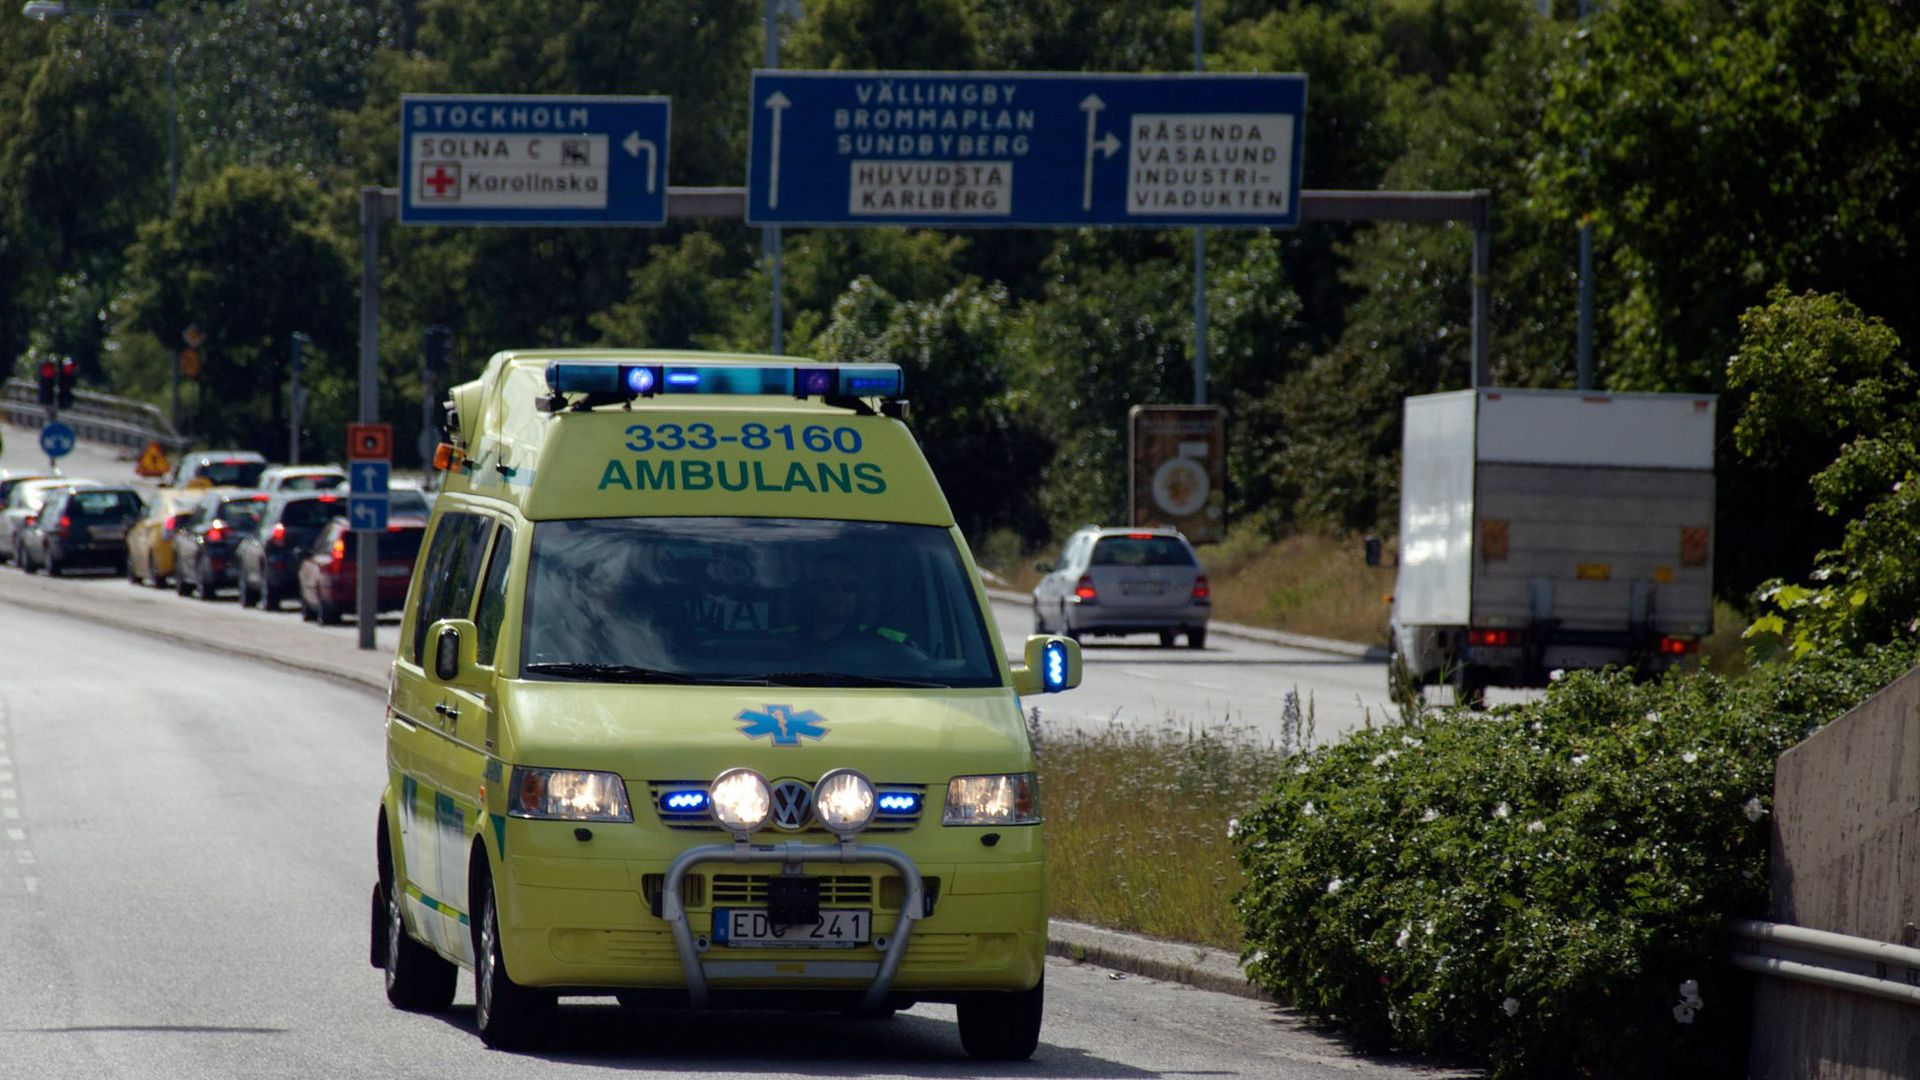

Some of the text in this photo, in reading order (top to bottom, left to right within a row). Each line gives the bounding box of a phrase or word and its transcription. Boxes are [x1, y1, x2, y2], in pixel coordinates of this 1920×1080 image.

[856, 80, 1016, 104] VÄLLINGBY
[413, 105, 589, 127] STOCKHOLM
[834, 108, 1034, 129] BROMMAPLAN
[1138, 120, 1262, 140] RÅSUNDA
[421, 138, 541, 158] SOLNA C
[838, 134, 1030, 155] SUNDBYBERG
[1138, 146, 1276, 164] VASALUND
[468, 172, 599, 192] Karolinska
[859, 166, 1003, 185] HUVUDSTA
[1135, 168, 1271, 185] INDUSTRI-
[861, 190, 998, 209] KARLBERG
[1136, 190, 1282, 207] VIADUKTEN
[625, 423, 863, 454] 333-8160
[598, 459, 887, 494] AMBULANS
[809, 914, 861, 938] 241
